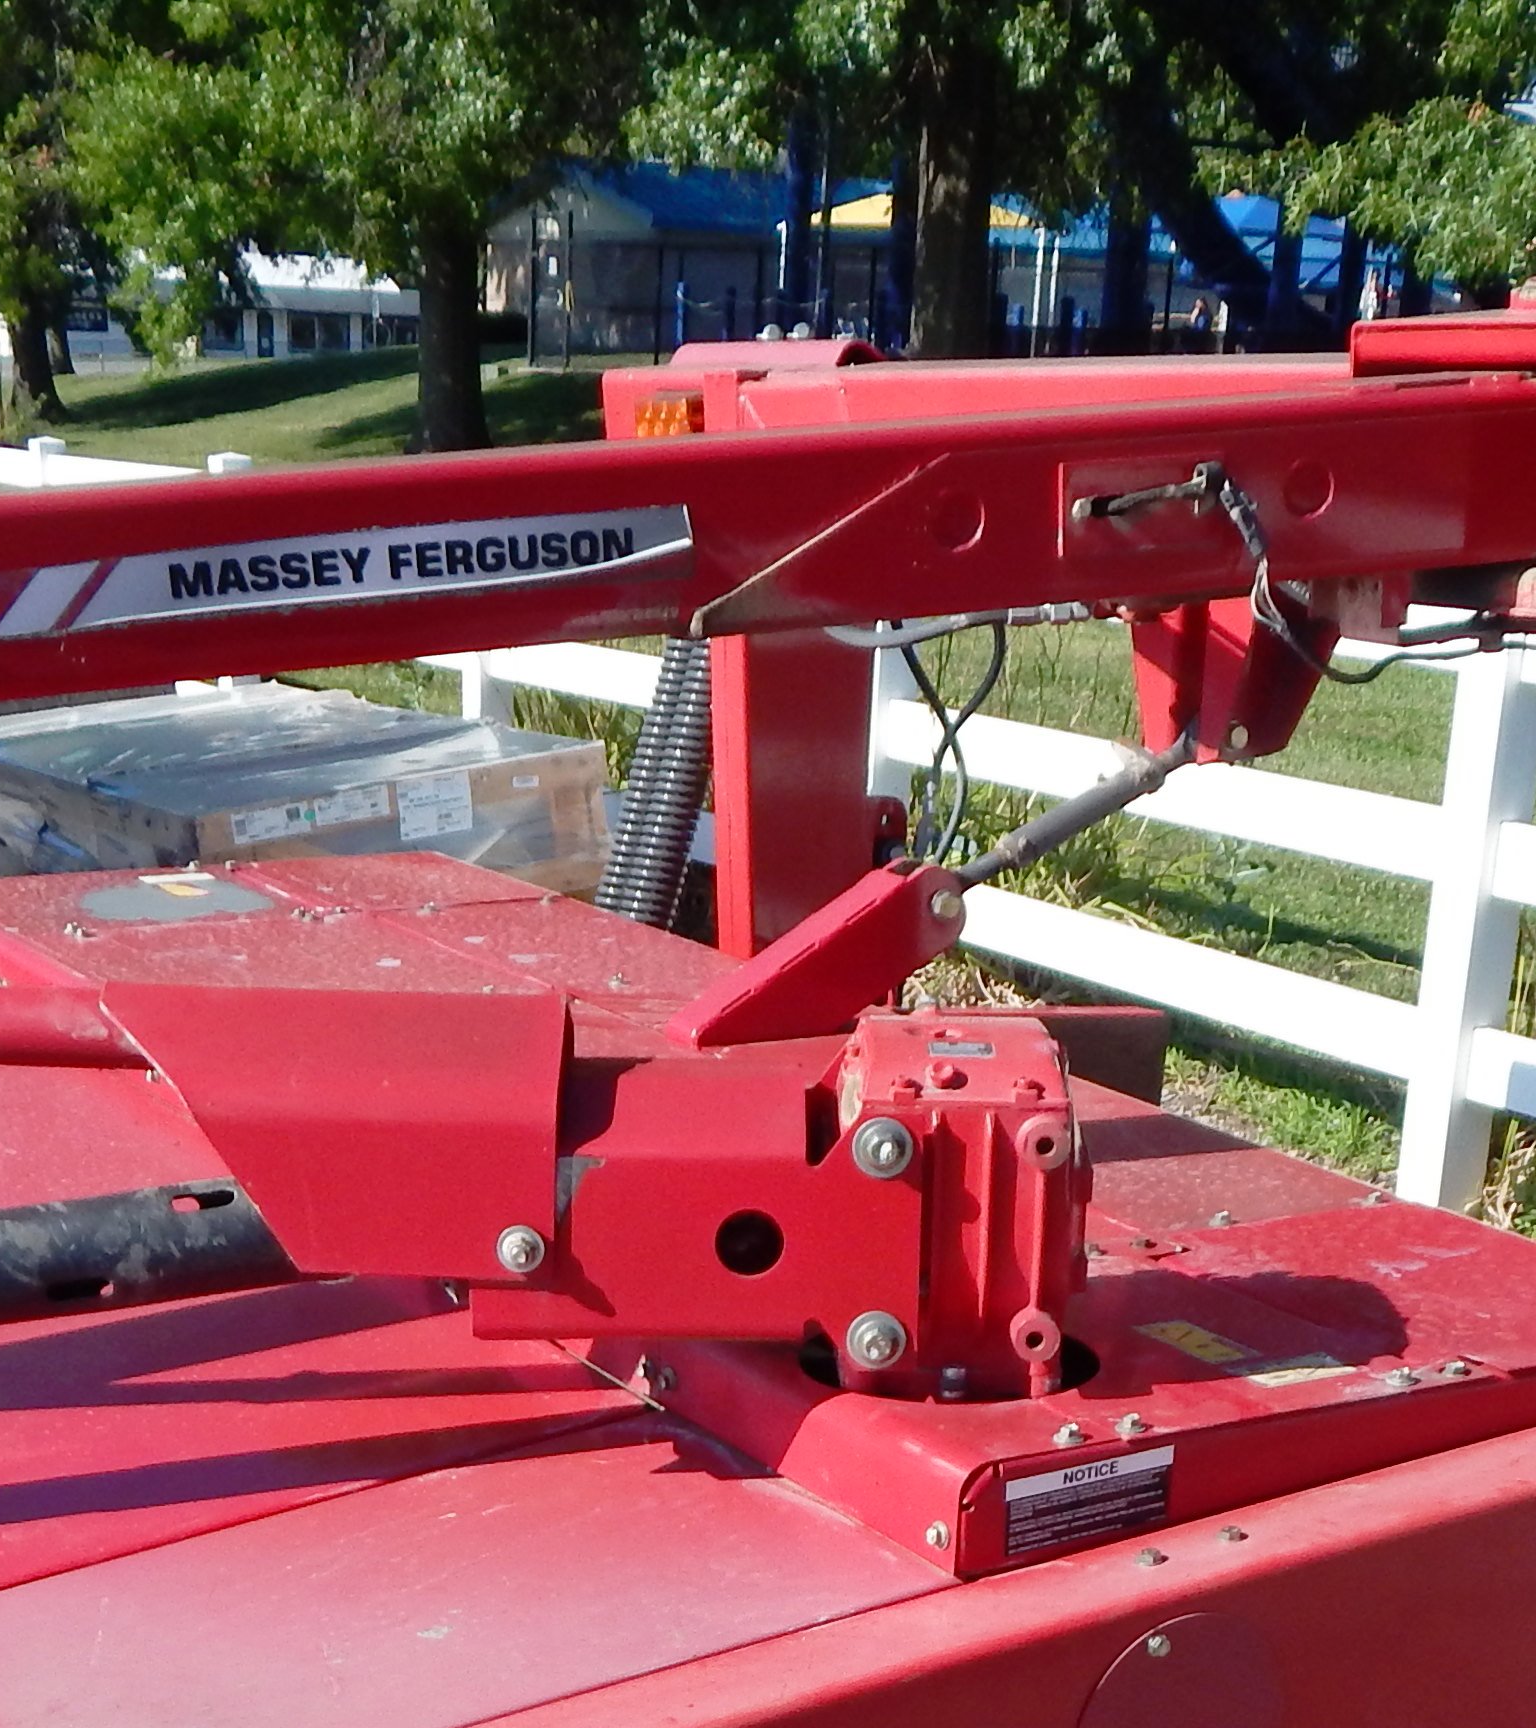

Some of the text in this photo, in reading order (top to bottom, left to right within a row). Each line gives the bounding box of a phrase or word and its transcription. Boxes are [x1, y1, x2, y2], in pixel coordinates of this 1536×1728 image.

[168, 528, 633, 599] MASSEY FERGUSON
[1063, 1460, 1119, 1485] NOTICE
